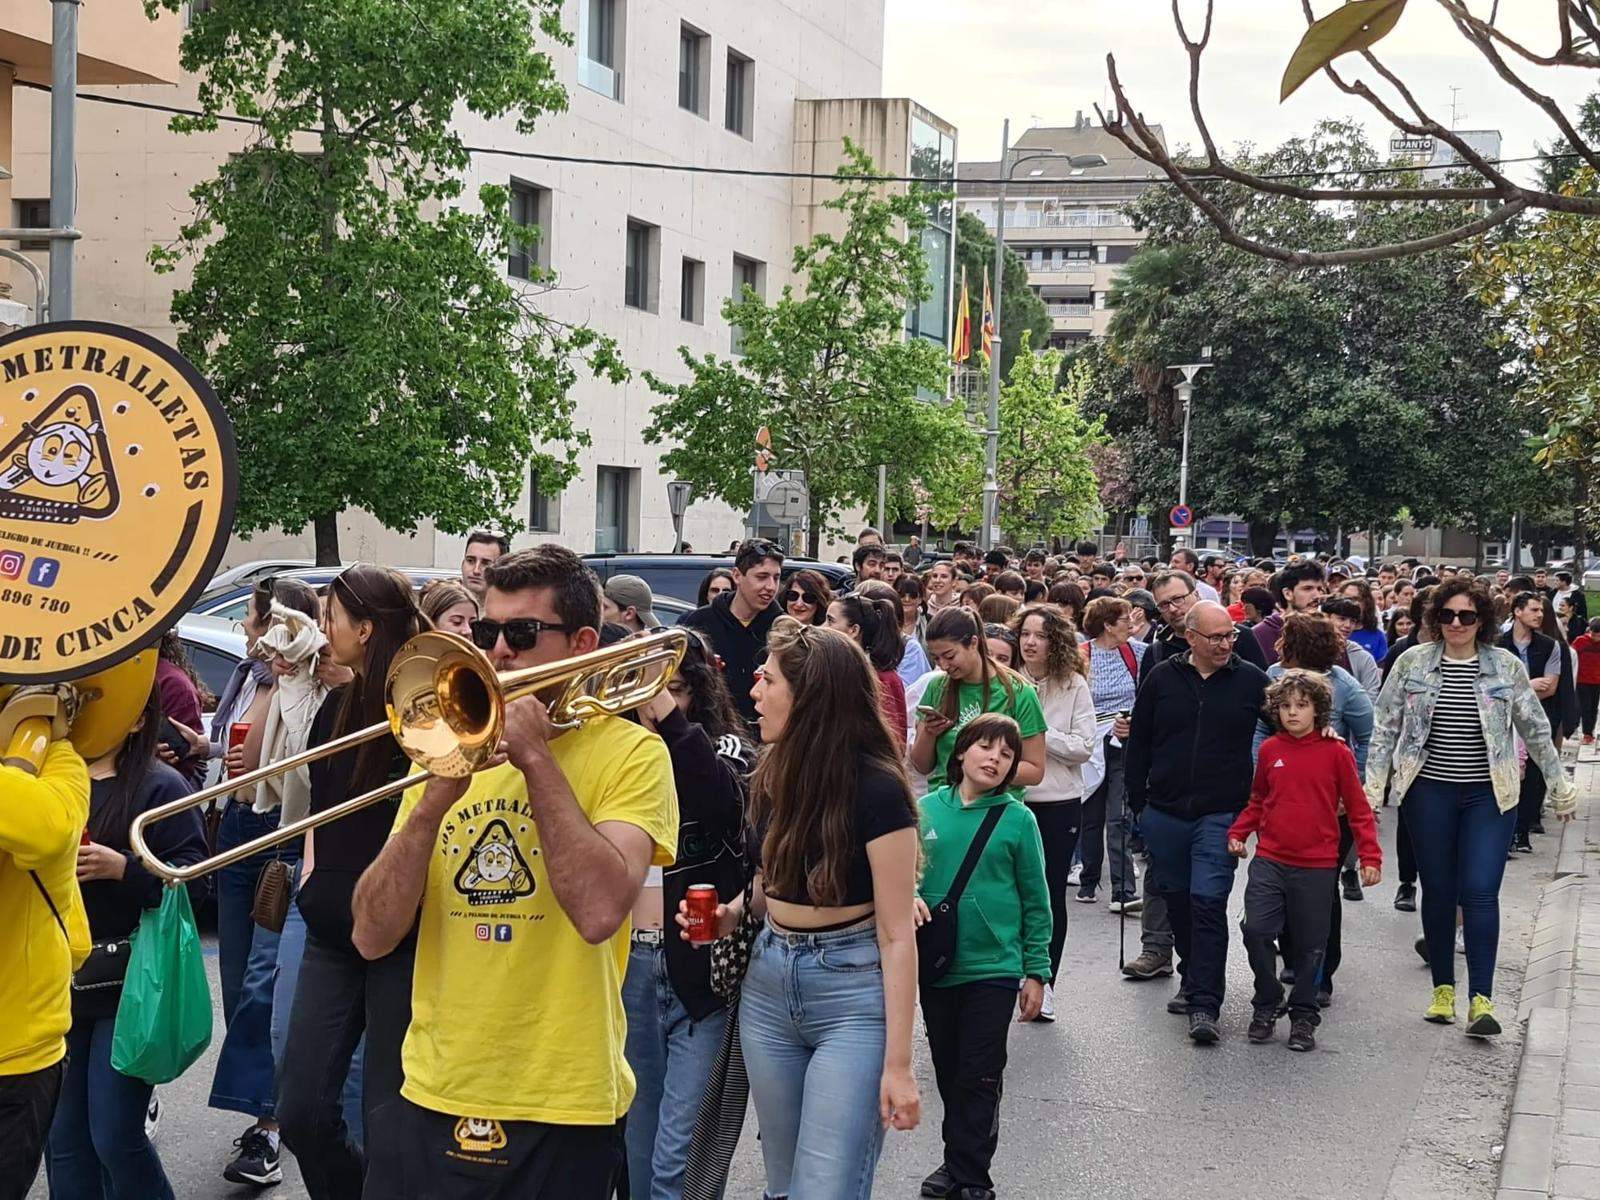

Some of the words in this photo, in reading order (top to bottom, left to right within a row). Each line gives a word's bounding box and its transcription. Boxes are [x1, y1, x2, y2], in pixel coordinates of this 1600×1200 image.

[1, 345, 209, 492] METRALLETAS
[31, 536, 44, 547] DE
[45, 540, 81, 554] JUERGA
[1, 588, 33, 606] 896
[40, 596, 71, 614] 780
[0, 635, 42, 661] DE
[56, 596, 156, 657] CINCA
